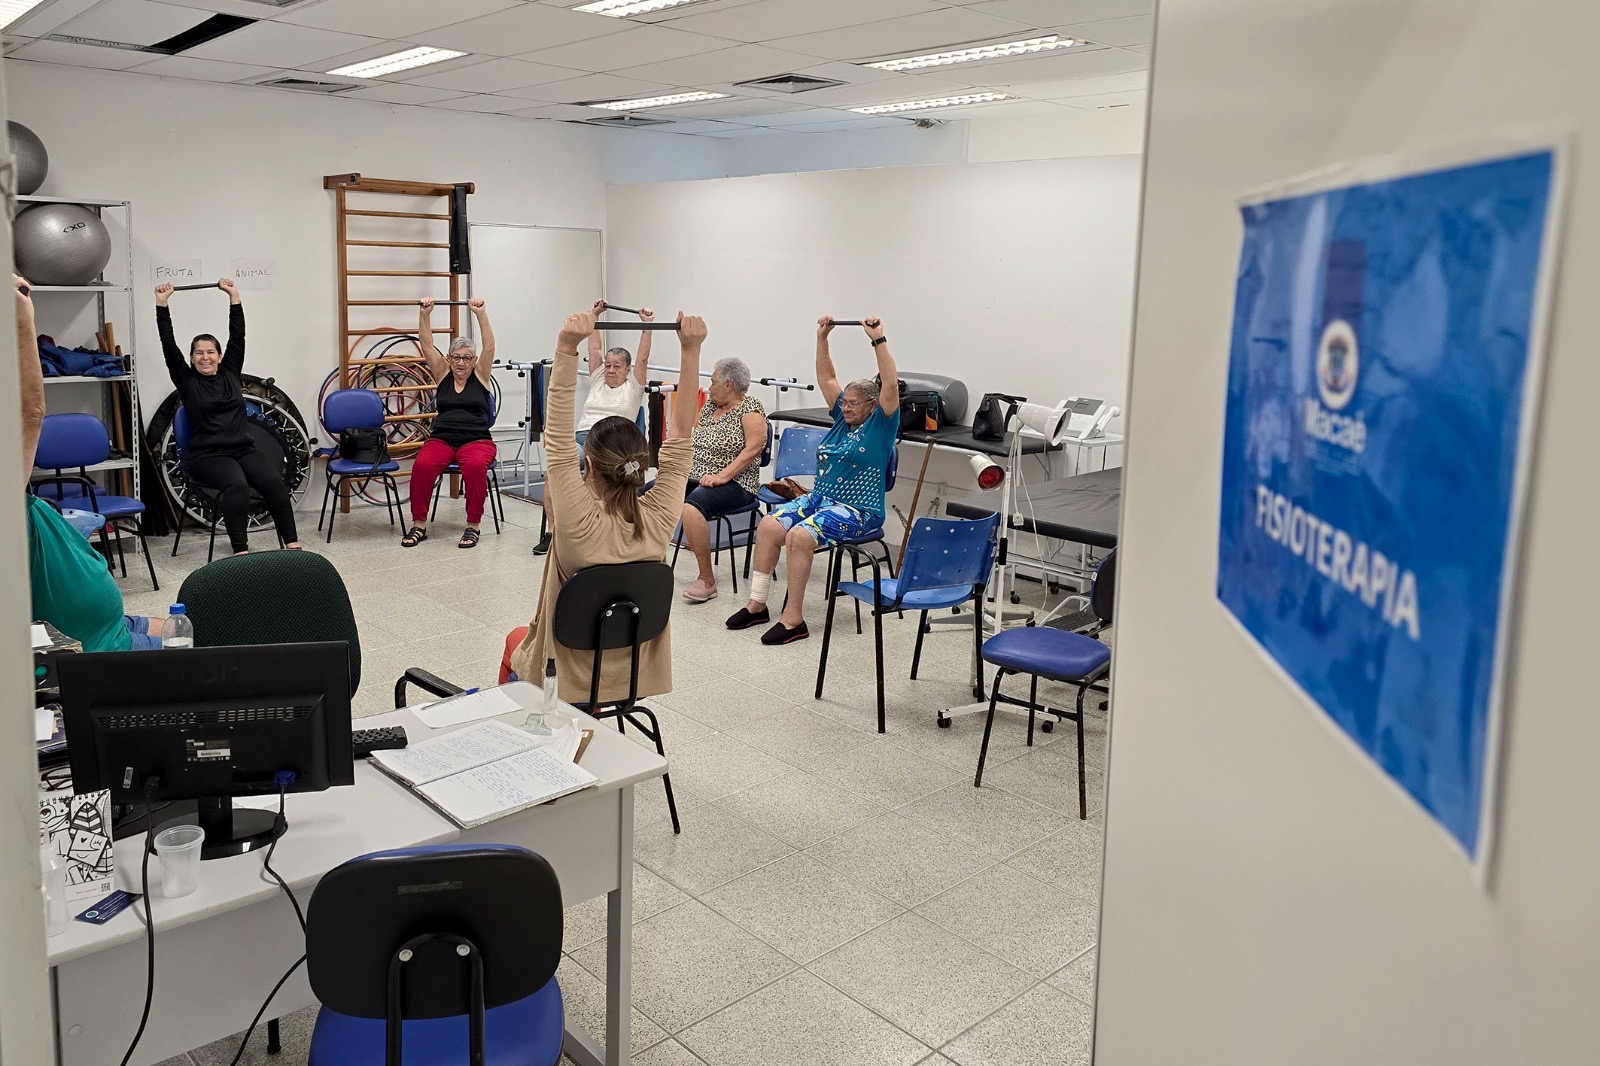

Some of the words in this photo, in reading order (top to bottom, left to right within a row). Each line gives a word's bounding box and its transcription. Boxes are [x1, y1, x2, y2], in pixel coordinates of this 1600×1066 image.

[156, 266, 194, 278] FRUTA
[235, 268, 271, 278] ANIMAL
[1255, 485, 1420, 639] FISIOTERAPIA
